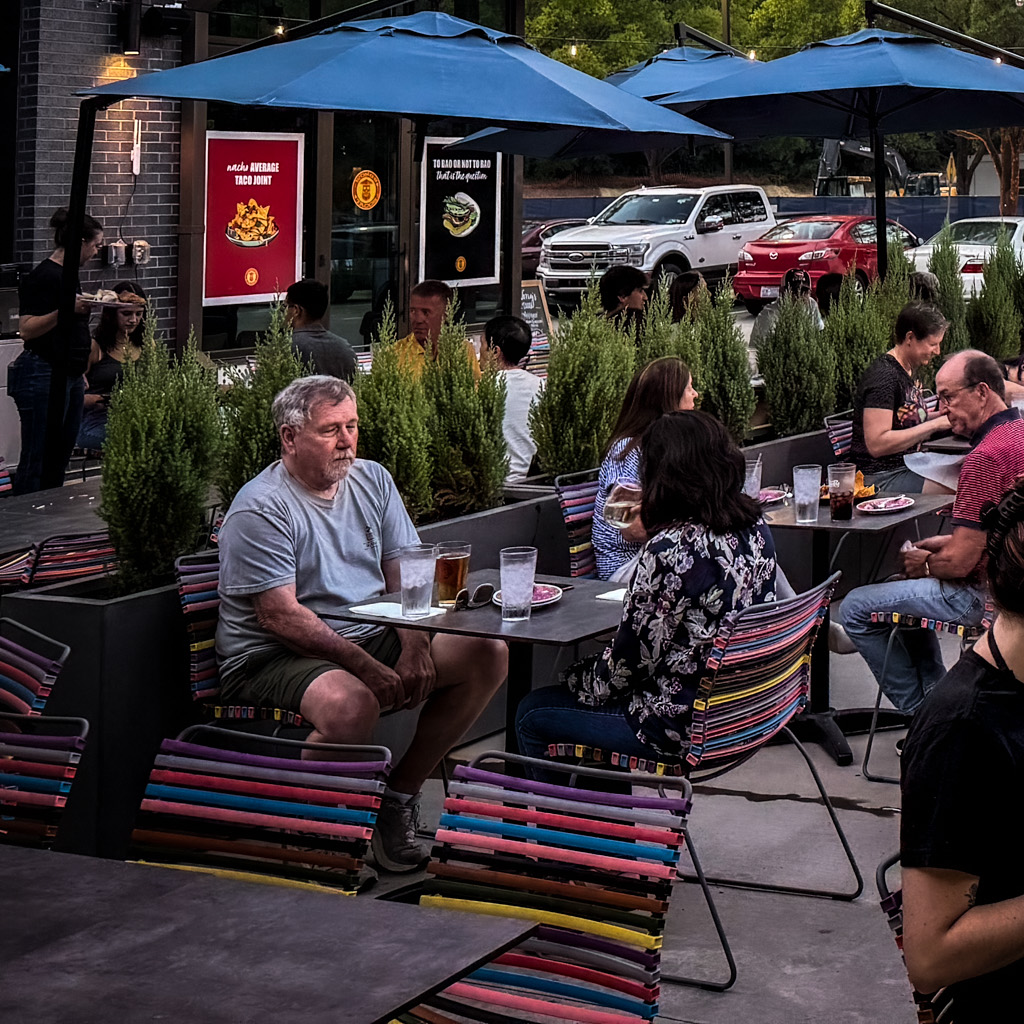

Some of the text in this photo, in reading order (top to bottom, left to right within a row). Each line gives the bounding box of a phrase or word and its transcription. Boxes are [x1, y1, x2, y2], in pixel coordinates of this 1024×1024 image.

[226, 161, 280, 173] nacho AVERAGE
[432, 159, 441, 169] TO
[461, 159, 472, 169] NOT
[472, 159, 480, 169] TO
[235, 175, 272, 186] TACO JOINT
[436, 170, 450, 181] that
[455, 170, 465, 180] the
[464, 170, 488, 183] question
